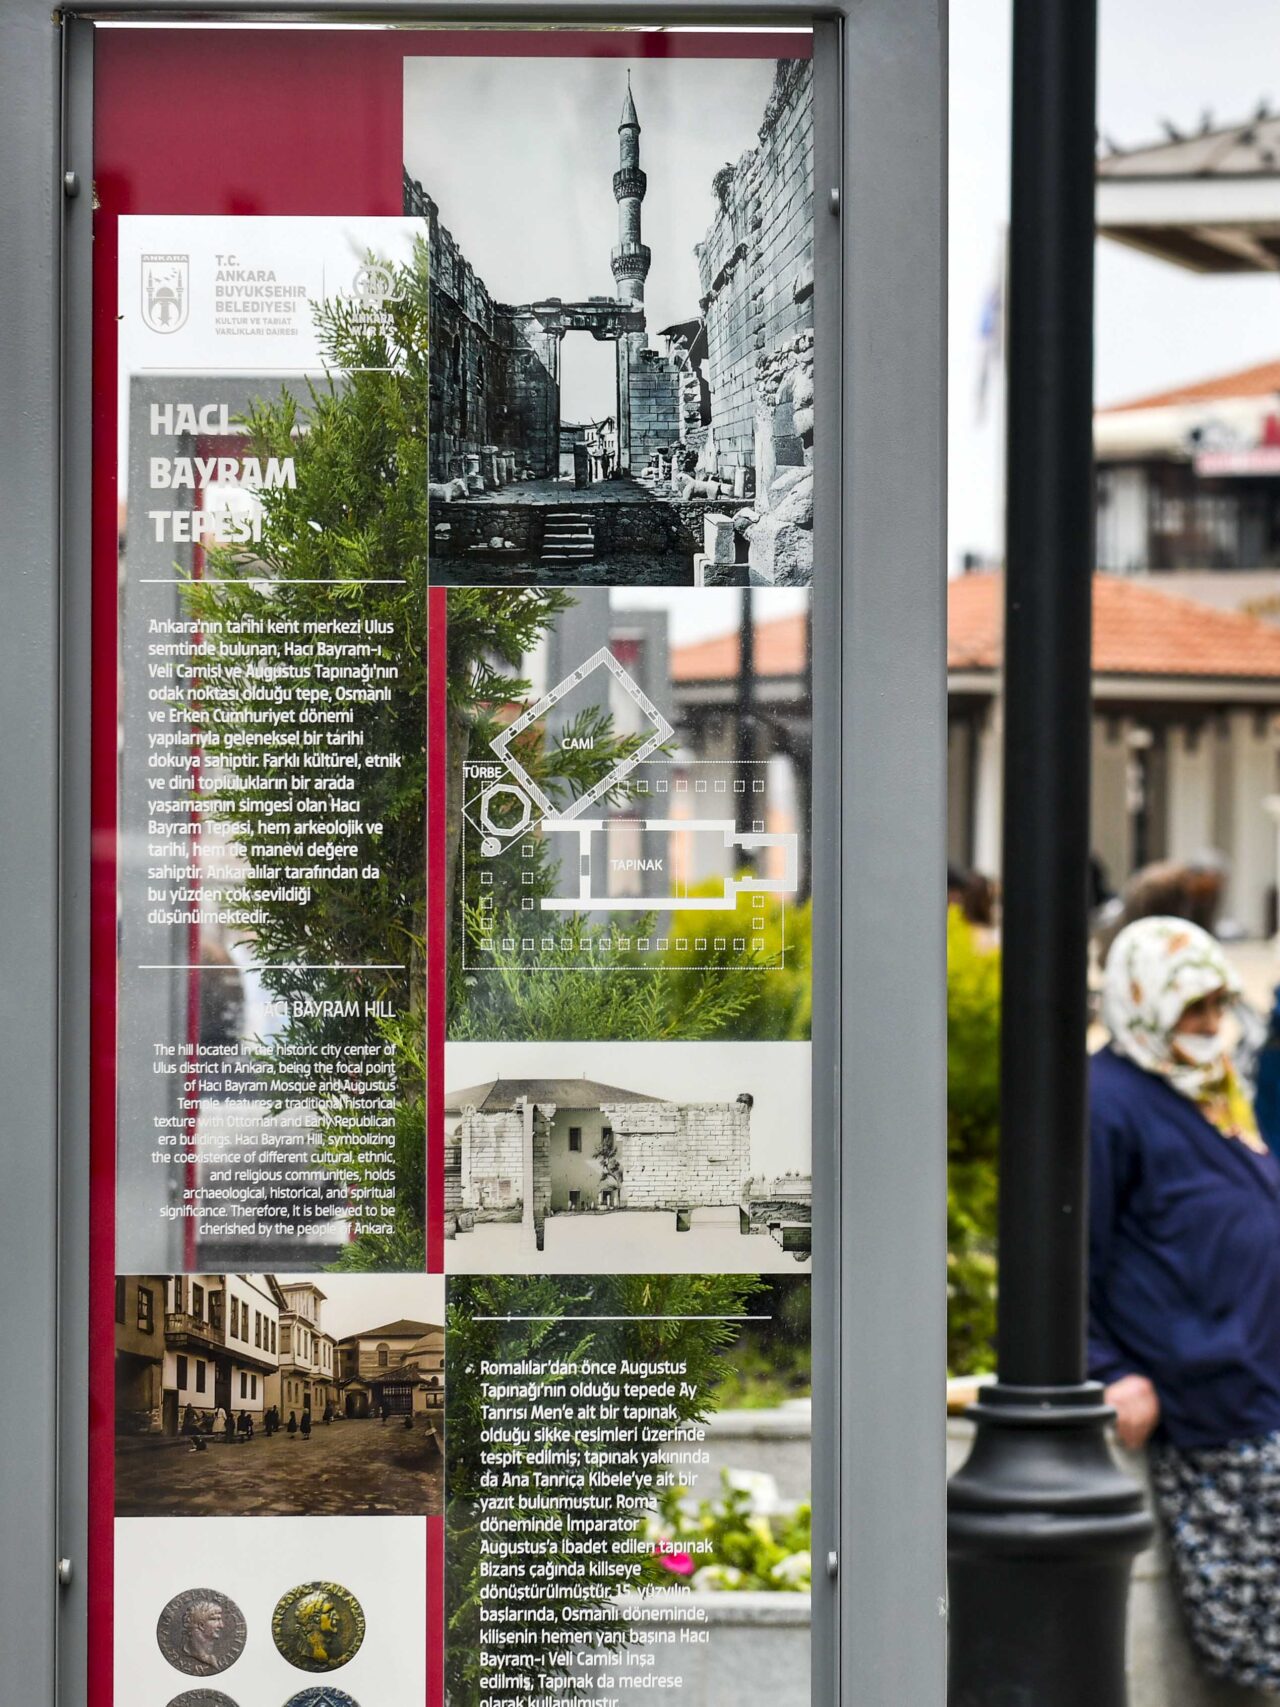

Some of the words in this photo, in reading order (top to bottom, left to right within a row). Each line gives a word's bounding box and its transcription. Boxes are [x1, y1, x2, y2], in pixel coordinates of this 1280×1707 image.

[215, 255, 240, 267] T.C.
[215, 270, 277, 282] ANKARA
[149, 403, 229, 436] HACI
[149, 456, 298, 490] BAYRAM
[148, 619, 223, 634] Ankara'nın
[226, 619, 264, 634] tarihi
[267, 619, 300, 634] kent
[303, 619, 362, 634] merkezi
[364, 619, 395, 634] Ulus
[148, 641, 216, 656] semtinde
[220, 641, 281, 659] bulunan,
[284, 641, 314, 656] Hacı
[316, 641, 382, 660] Bayram-ı
[148, 663, 173, 679] Veli
[176, 663, 222, 679] Camisi
[245, 663, 311, 682] Augustus
[313, 663, 399, 682] Tapınağı'nın
[148, 685, 184, 701] odak
[187, 685, 240, 701] noktası
[243, 685, 292, 704] olduğu
[295, 685, 333, 704] tepe,
[335, 685, 392, 701] Osmanlı
[169, 708, 210, 723] Erken
[212, 708, 296, 726] Cumhuriyet
[298, 708, 354, 723] dönemi
[148, 730, 220, 749] yapılarıyla
[223, 730, 300, 749] geleneksel
[303, 730, 323, 745] bir
[325, 730, 364, 745] tarihi
[561, 735, 594, 750] CAMİ
[148, 752, 201, 771] dokuya
[203, 752, 260, 771] sahiptir.
[263, 752, 300, 768] Farklı
[303, 752, 362, 770] kültürel,
[364, 752, 402, 768] etnik
[463, 765, 503, 779] TÜRBE
[168, 775, 195, 790] dini
[198, 775, 288, 794] toplulukların
[290, 775, 311, 790] bir
[313, 775, 355, 790] arada
[148, 801, 236, 816] yaşamasının
[239, 797, 293, 816] simgesi
[296, 797, 327, 813] olan
[330, 797, 361, 813] Hacı
[148, 819, 202, 838] Bayram
[257, 819, 291, 835] hem
[293, 819, 364, 838] arkeolojik
[148, 842, 189, 860] tarihi,
[251, 842, 304, 857] manevi
[306, 842, 359, 861] değere
[148, 864, 203, 883] sahiptir.
[284, 864, 358, 879] tarafından
[610, 859, 663, 871] TAPINAK
[169, 886, 222, 905] yüzden
[225, 886, 251, 904] çok
[254, 886, 311, 905] sevildiği
[148, 908, 271, 926] düşünülmektedir.
[293, 1000, 360, 1018] BAYRAM
[364, 1000, 397, 1018] HILL
[153, 1043, 175, 1056] The
[178, 1043, 194, 1056] hill
[195, 1043, 239, 1056] located
[276, 1043, 318, 1056] historic
[320, 1043, 341, 1059] city
[343, 1043, 382, 1056] center
[383, 1043, 396, 1056] of
[183, 1078, 197, 1092] of
[198, 1078, 222, 1092] Hacı
[224, 1078, 268, 1095] Bayram
[269, 1078, 316, 1095] Mosque
[318, 1078, 341, 1092] and
[343, 1078, 396, 1095] Augustus
[209, 1168, 232, 1181] and
[234, 1168, 283, 1184] religious
[285, 1168, 362, 1183] communities,
[364, 1168, 396, 1181] holds
[183, 1185, 268, 1202] archaeological,
[269, 1185, 324, 1201] historical,
[325, 1185, 348, 1199] and
[350, 1185, 396, 1202] spiritual
[480, 1360, 578, 1375] Romalılar'dan
[581, 1360, 617, 1375] önce
[619, 1360, 687, 1378] Augustus
[480, 1382, 567, 1401] Tapınağı'nın
[569, 1382, 621, 1401] olduğu
[623, 1382, 676, 1401] tepede
[679, 1382, 697, 1401] Ay
[480, 1404, 528, 1419] Tanrısı
[530, 1404, 574, 1419] Men'e
[576, 1404, 596, 1419] ait
[599, 1404, 620, 1419] bir
[623, 1404, 678, 1423] tapınak
[480, 1427, 531, 1445] olduğu
[533, 1427, 571, 1442] sikke
[574, 1427, 638, 1442] resimleri
[641, 1427, 706, 1442] üzerinde
[480, 1449, 523, 1468] tespit
[525, 1449, 581, 1467] edilmiş;
[584, 1449, 639, 1468] tapınak
[641, 1449, 710, 1468] yakınında
[480, 1472, 499, 1487] da
[501, 1472, 529, 1487] Ana
[532, 1472, 585, 1489] Tanrıça
[588, 1472, 651, 1490] Kibele'ye
[655, 1472, 675, 1487] ait
[678, 1472, 698, 1487] bir
[479, 1494, 515, 1513] yazıt
[518, 1494, 613, 1512] bulunmuştur.
[616, 1494, 658, 1509] Roma
[480, 1516, 563, 1531] döneminde
[566, 1515, 640, 1535] İmparator
[480, 1539, 558, 1557] Augustus'a
[561, 1539, 608, 1554] ibadet
[611, 1539, 656, 1554] edilen
[658, 1539, 714, 1557] tapınak
[480, 1562, 526, 1576] Bizans
[529, 1562, 585, 1580] çağında
[589, 1562, 642, 1580] kiliseye
[479, 1607, 558, 1624] başlarında,
[561, 1607, 620, 1621] Osmanlı
[622, 1607, 709, 1624] döneminde,
[479, 1629, 538, 1644] kilisenin
[541, 1629, 593, 1644] hemen
[595, 1632, 626, 1647] yanı
[629, 1629, 676, 1646] başına
[680, 1629, 710, 1644] Hacı
[479, 1651, 545, 1669] Bayram-ı
[548, 1651, 573, 1666] Veli
[576, 1651, 623, 1666] Camisi
[626, 1651, 655, 1668] inşa
[479, 1673, 535, 1691] edilmiş,
[537, 1673, 594, 1692] Tapınak
[596, 1673, 616, 1688] da
[618, 1673, 683, 1688] medrese
